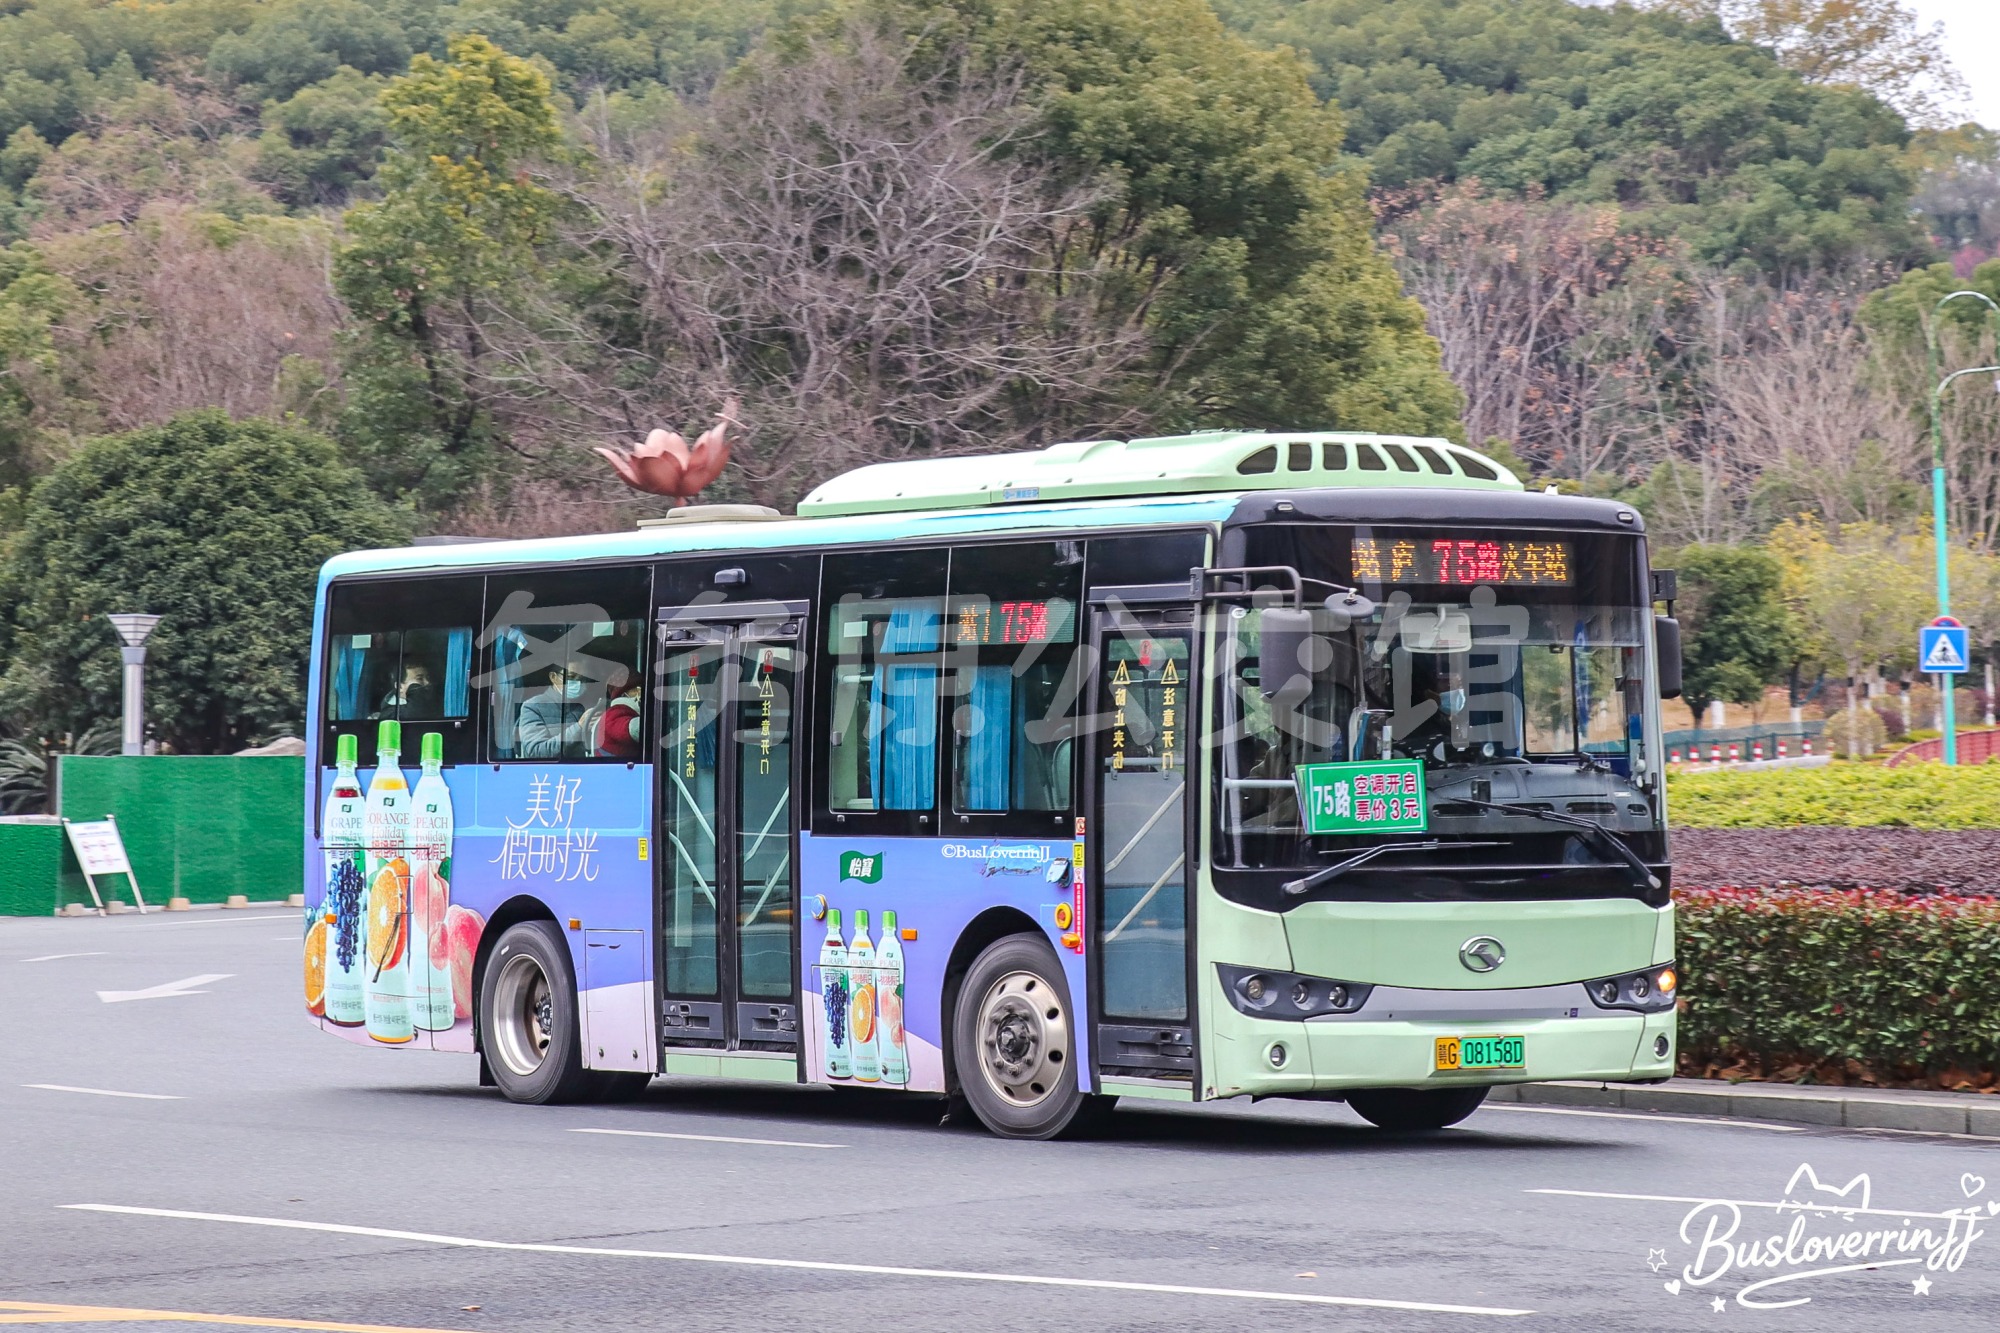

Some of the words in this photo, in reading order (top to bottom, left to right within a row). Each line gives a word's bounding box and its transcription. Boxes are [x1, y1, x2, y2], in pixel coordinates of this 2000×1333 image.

[1432, 541, 1501, 583] 75路
[1501, 543, 1567, 583] 火车站
[1353, 771, 1418, 797] 空调开启
[505, 773, 583, 830] 美好
[1313, 779, 1352, 818] 75路
[1354, 797, 1421, 822] 票价3元
[330, 817, 362, 829] GRAPE
[369, 812, 410, 825] ORANGE
[415, 817, 449, 829] PEACH
[371, 827, 405, 840] Holiday
[488, 826, 600, 882] 假日时光
